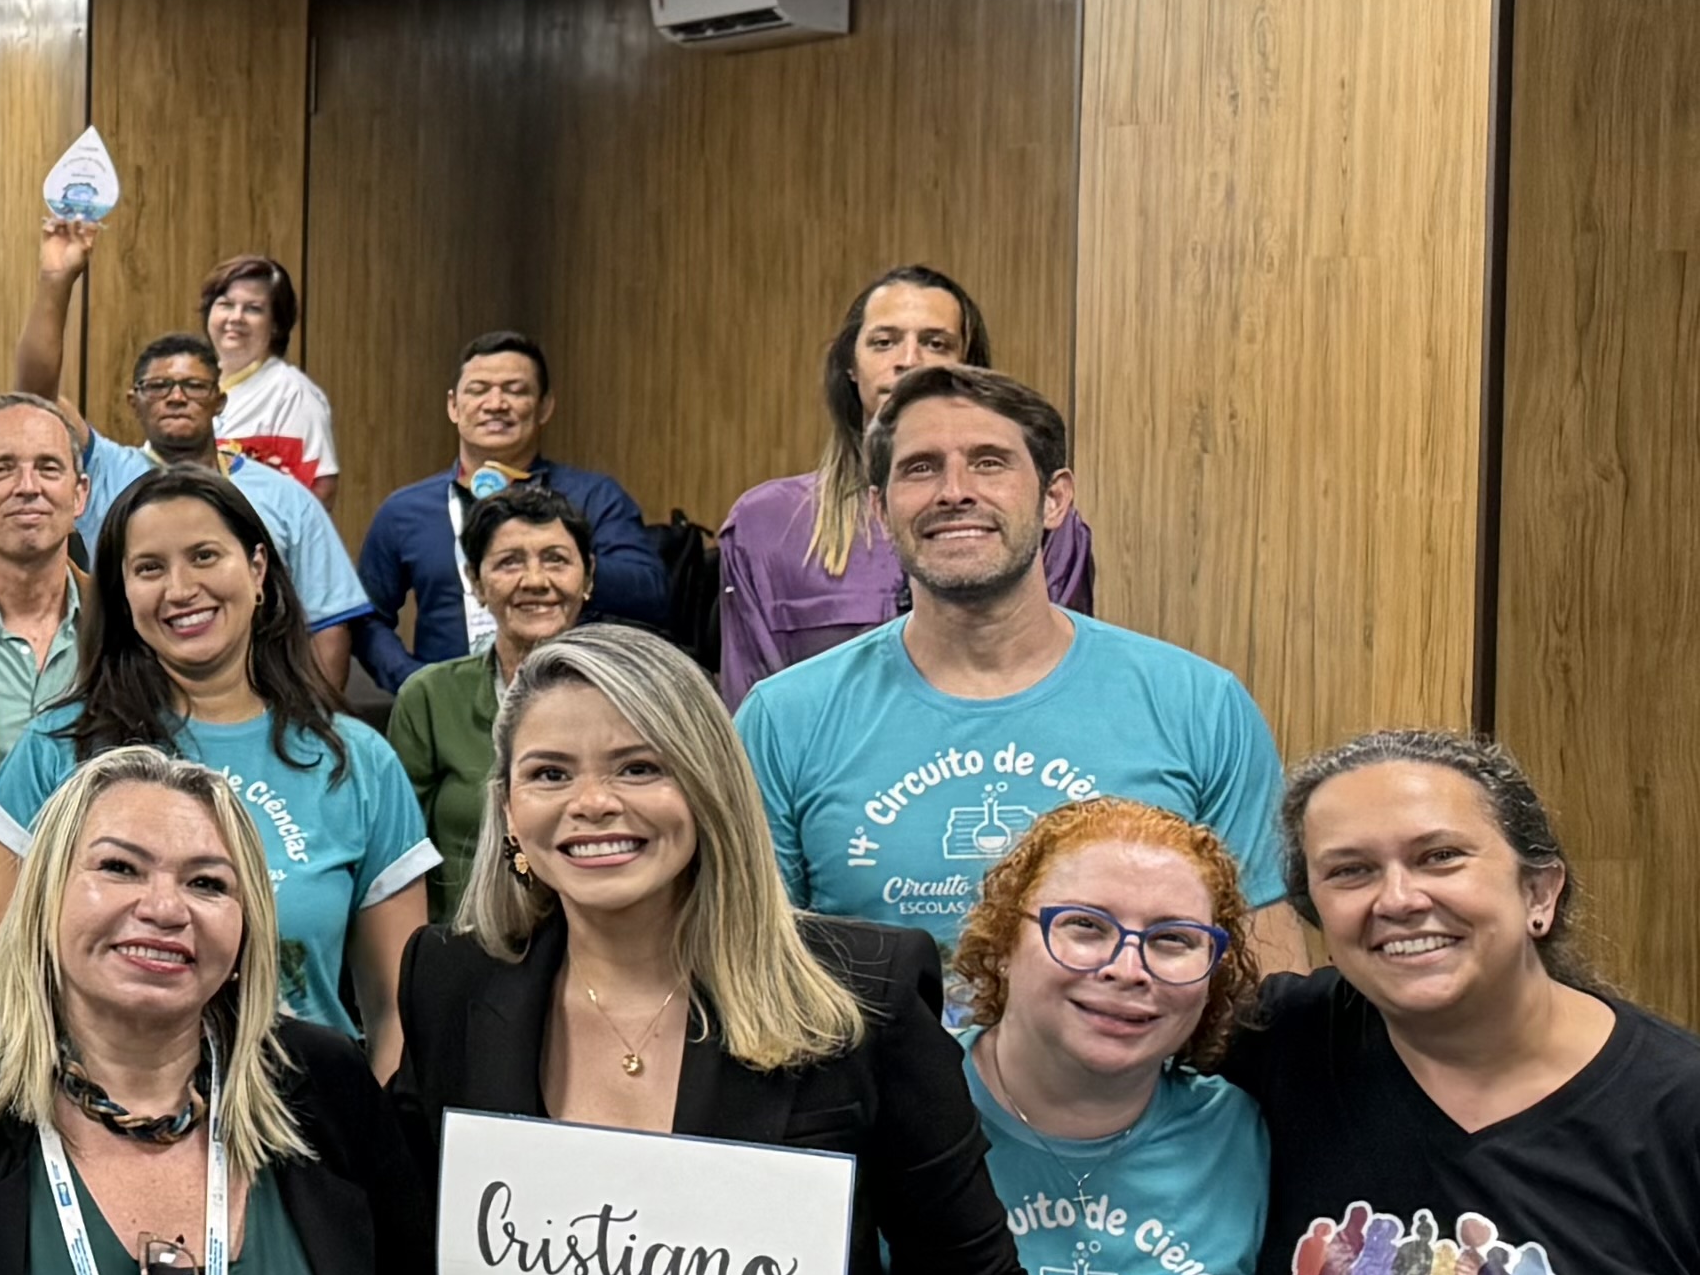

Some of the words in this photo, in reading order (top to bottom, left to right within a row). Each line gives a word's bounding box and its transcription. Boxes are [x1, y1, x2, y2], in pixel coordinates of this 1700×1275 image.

[864, 747, 985, 825] Circuito
[993, 741, 1035, 776] de
[246, 781, 309, 864] Ciências
[883, 874, 973, 904] Circuito
[899, 901, 966, 915] ESCOLAS
[1007, 1191, 1076, 1236] uito
[1085, 1194, 1128, 1236] de
